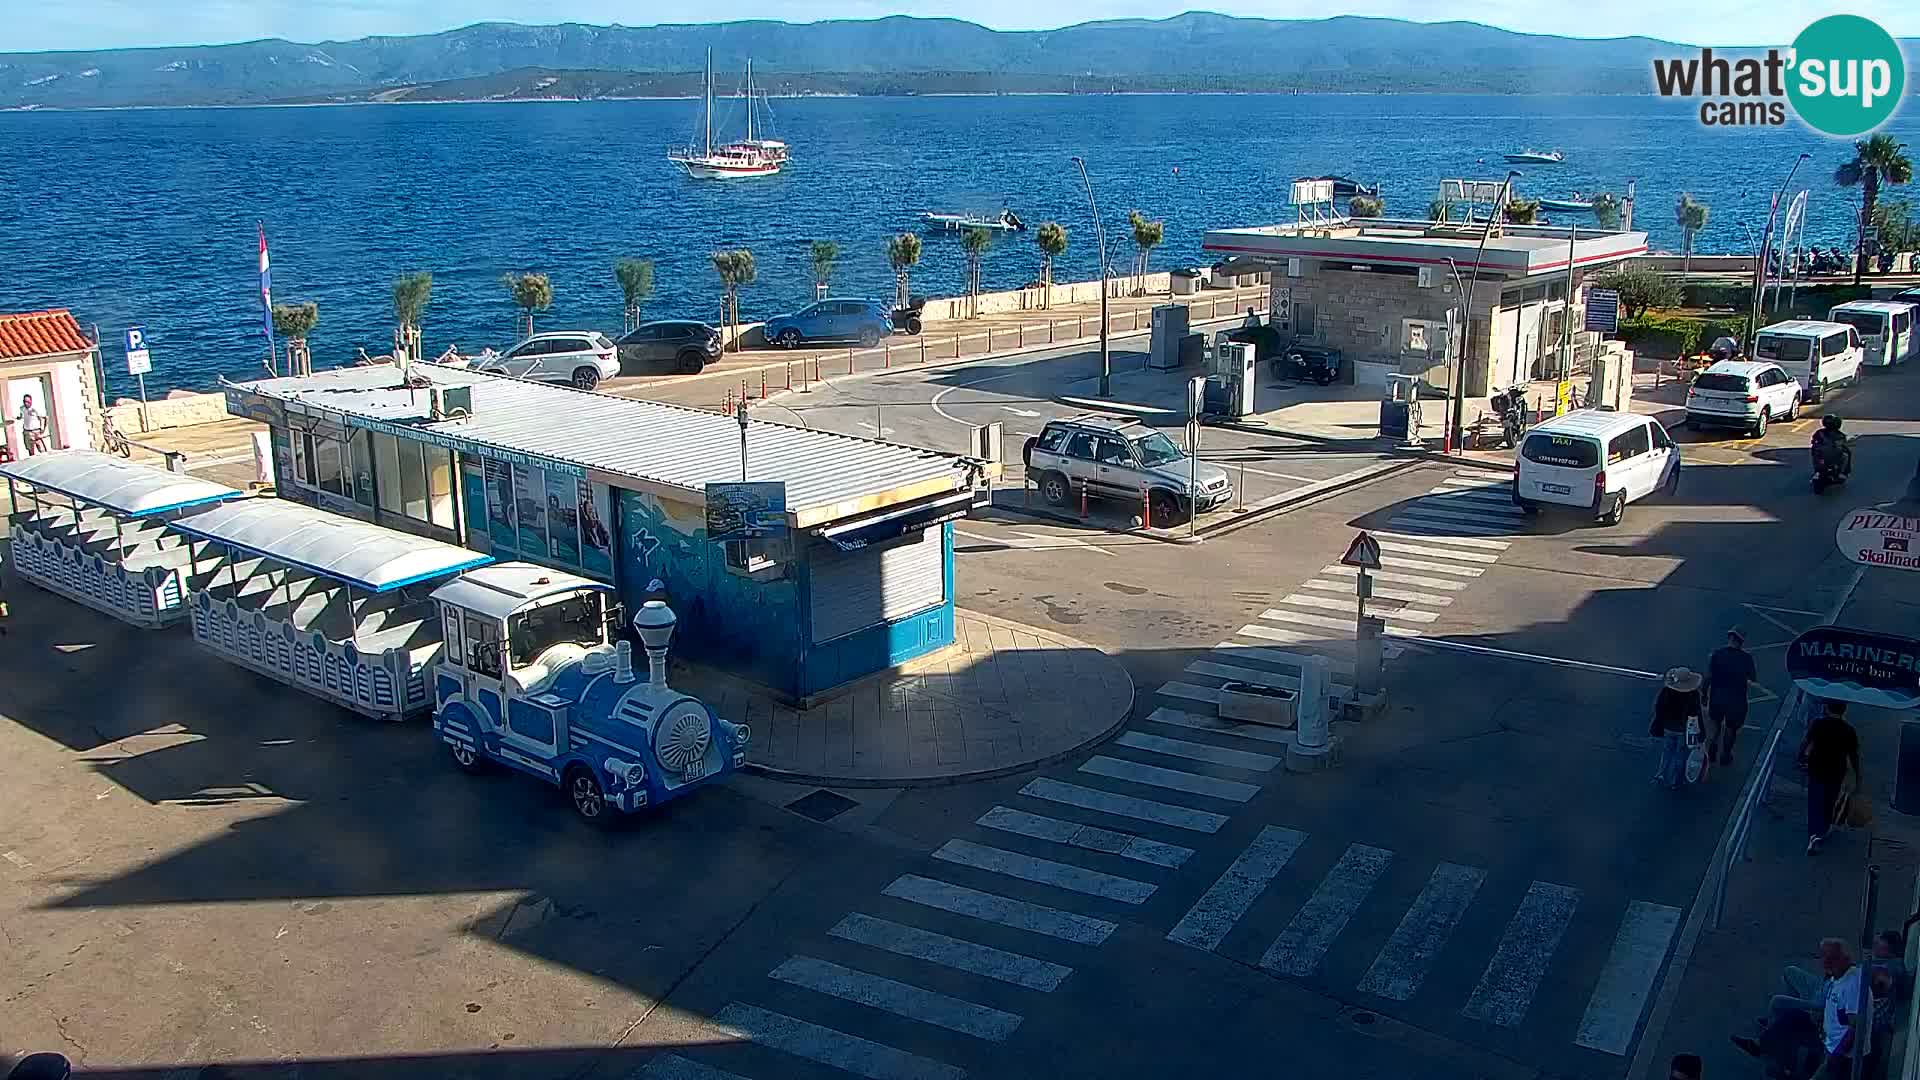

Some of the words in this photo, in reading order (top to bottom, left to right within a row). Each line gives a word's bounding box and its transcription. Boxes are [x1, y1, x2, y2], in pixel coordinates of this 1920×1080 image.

[1552, 437, 1572, 446] TAXI
[437, 436, 467, 450] POSTAJA
[478, 446, 493, 457] BUS
[493, 449, 526, 465] STATION
[528, 455, 553, 471] TICKET
[555, 463, 581, 477] OFFICE
[1869, 664, 1897, 680] bar
